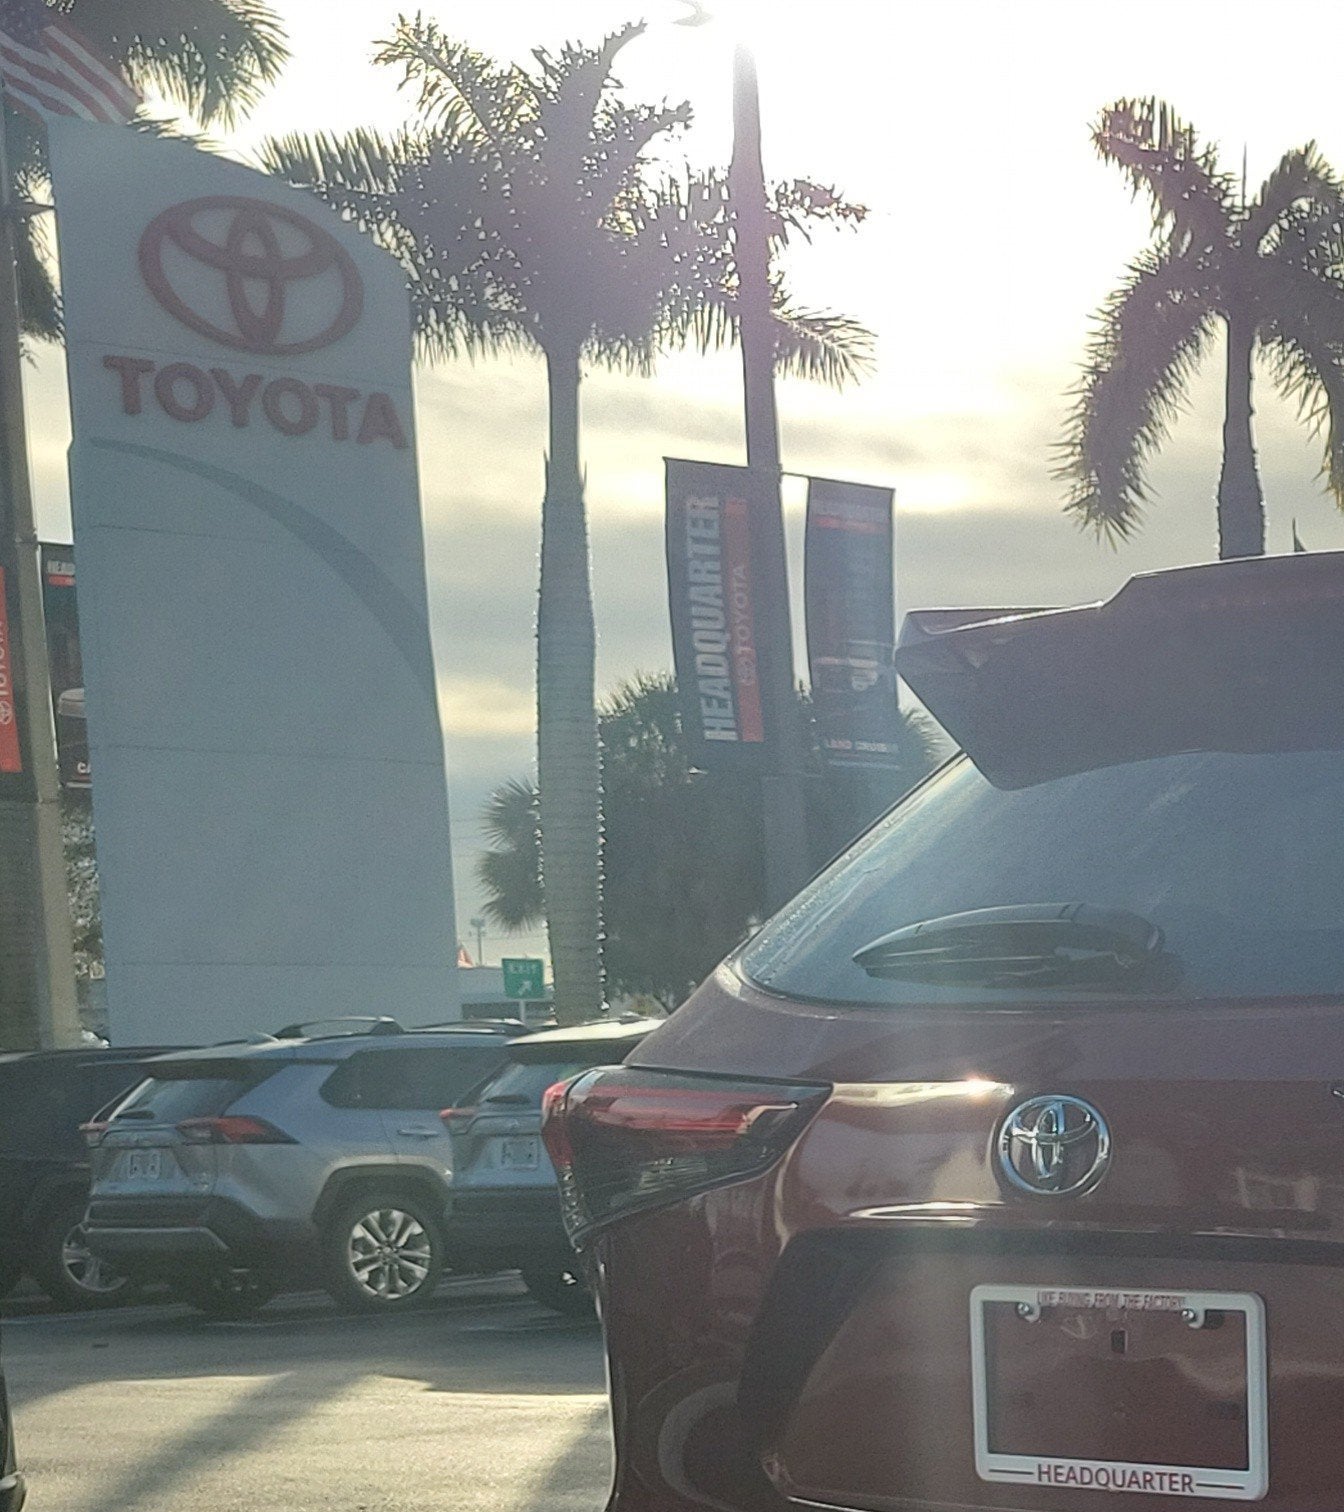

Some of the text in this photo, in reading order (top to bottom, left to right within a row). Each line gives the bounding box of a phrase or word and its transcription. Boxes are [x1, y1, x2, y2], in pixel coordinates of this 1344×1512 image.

[103, 355, 408, 450] TOYOTA
[686, 497, 738, 741] HEADQUARTER
[1036, 1464, 1195, 1493] HEADQUARTER
